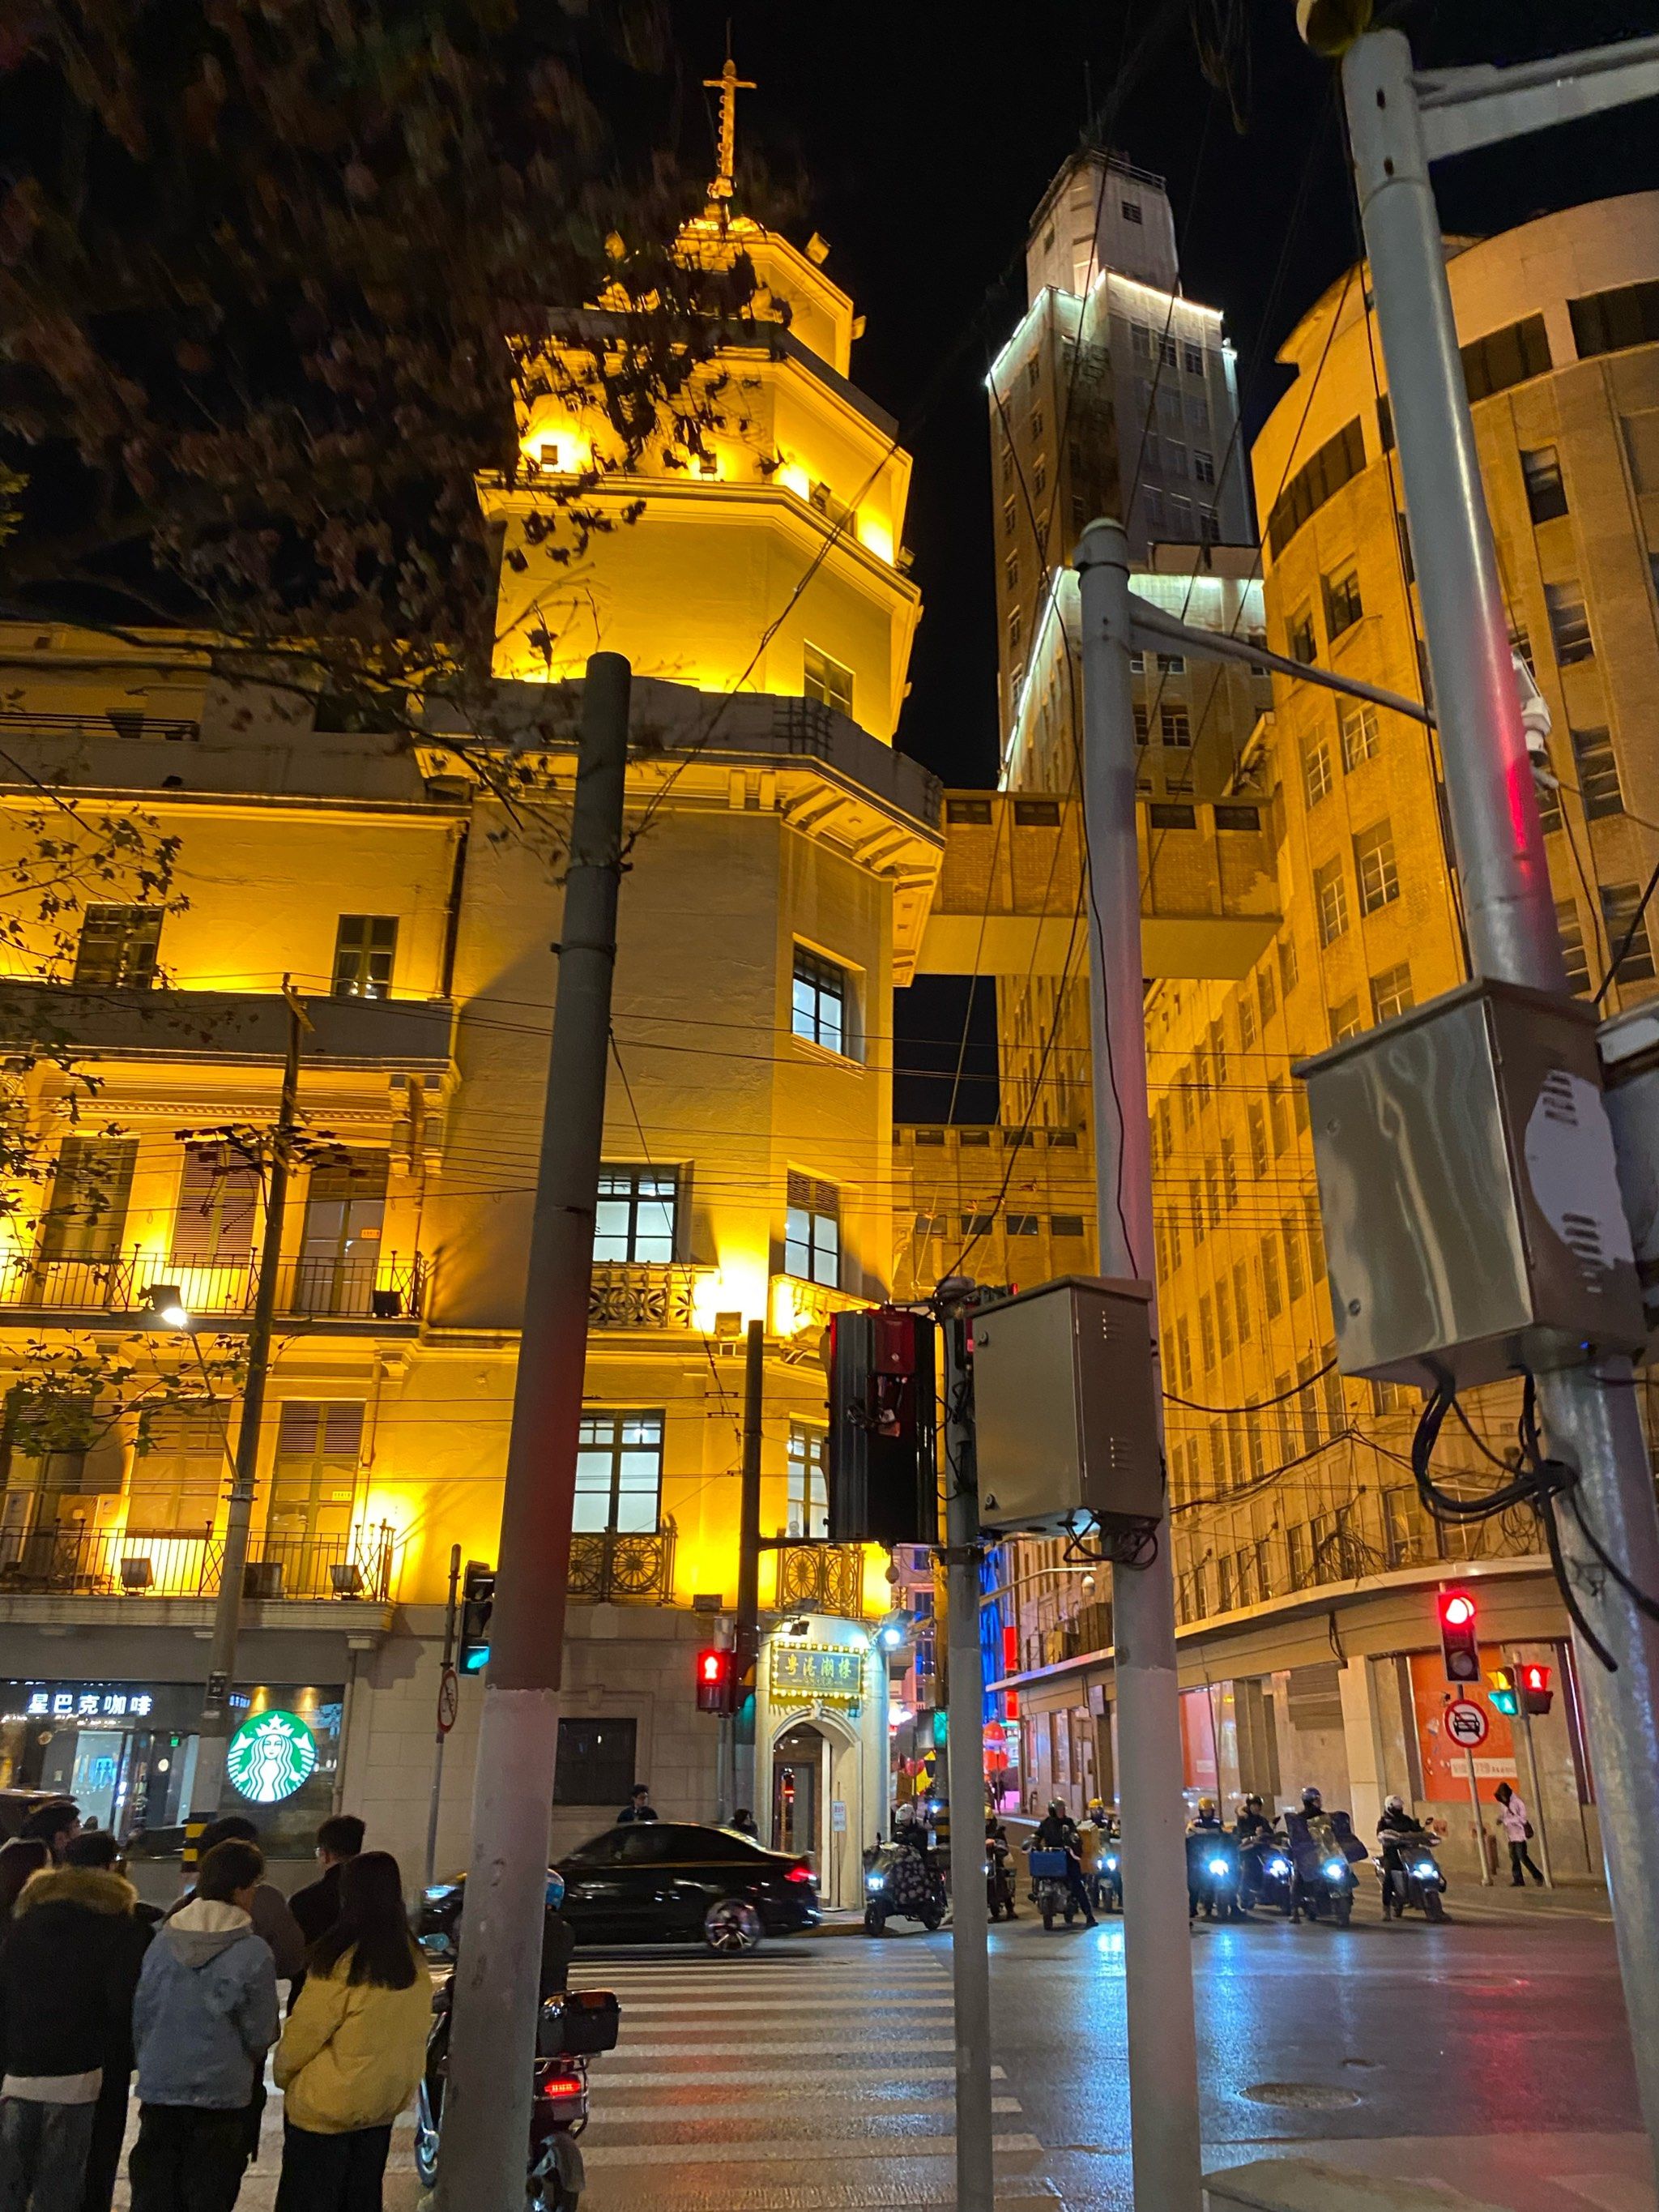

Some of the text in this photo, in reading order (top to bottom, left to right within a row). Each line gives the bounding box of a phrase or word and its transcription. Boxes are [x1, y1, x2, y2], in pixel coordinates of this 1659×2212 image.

[28, 1693, 152, 1716] 星巴克咖啡
